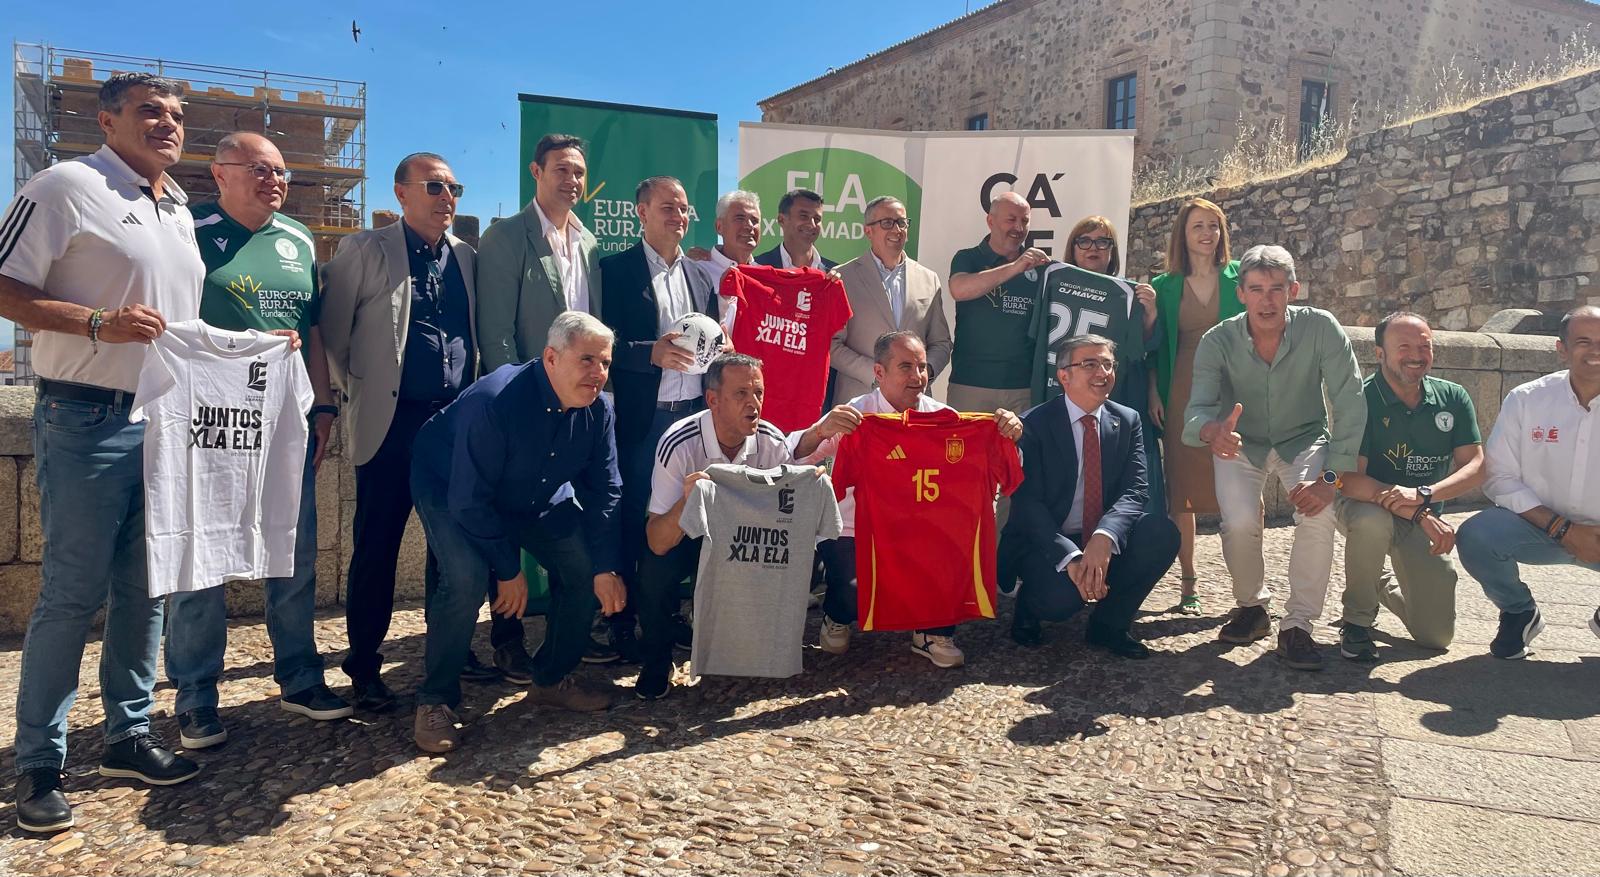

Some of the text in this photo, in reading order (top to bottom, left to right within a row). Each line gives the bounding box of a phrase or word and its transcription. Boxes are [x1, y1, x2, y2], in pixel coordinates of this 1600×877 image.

[259, 300, 297, 310] RURAL
[1003, 295, 1034, 304] EUROCA
[1071, 290, 1106, 302] MAVEN
[1002, 302, 1028, 310] RURAL
[760, 313, 808, 336] JUNTOS
[784, 333, 807, 351] ELA
[192, 406, 262, 429] JUNTOS
[232, 430, 262, 450] ELA
[911, 469, 940, 502] 15
[733, 526, 789, 547] JUNTOS
[763, 546, 789, 565] ELA
